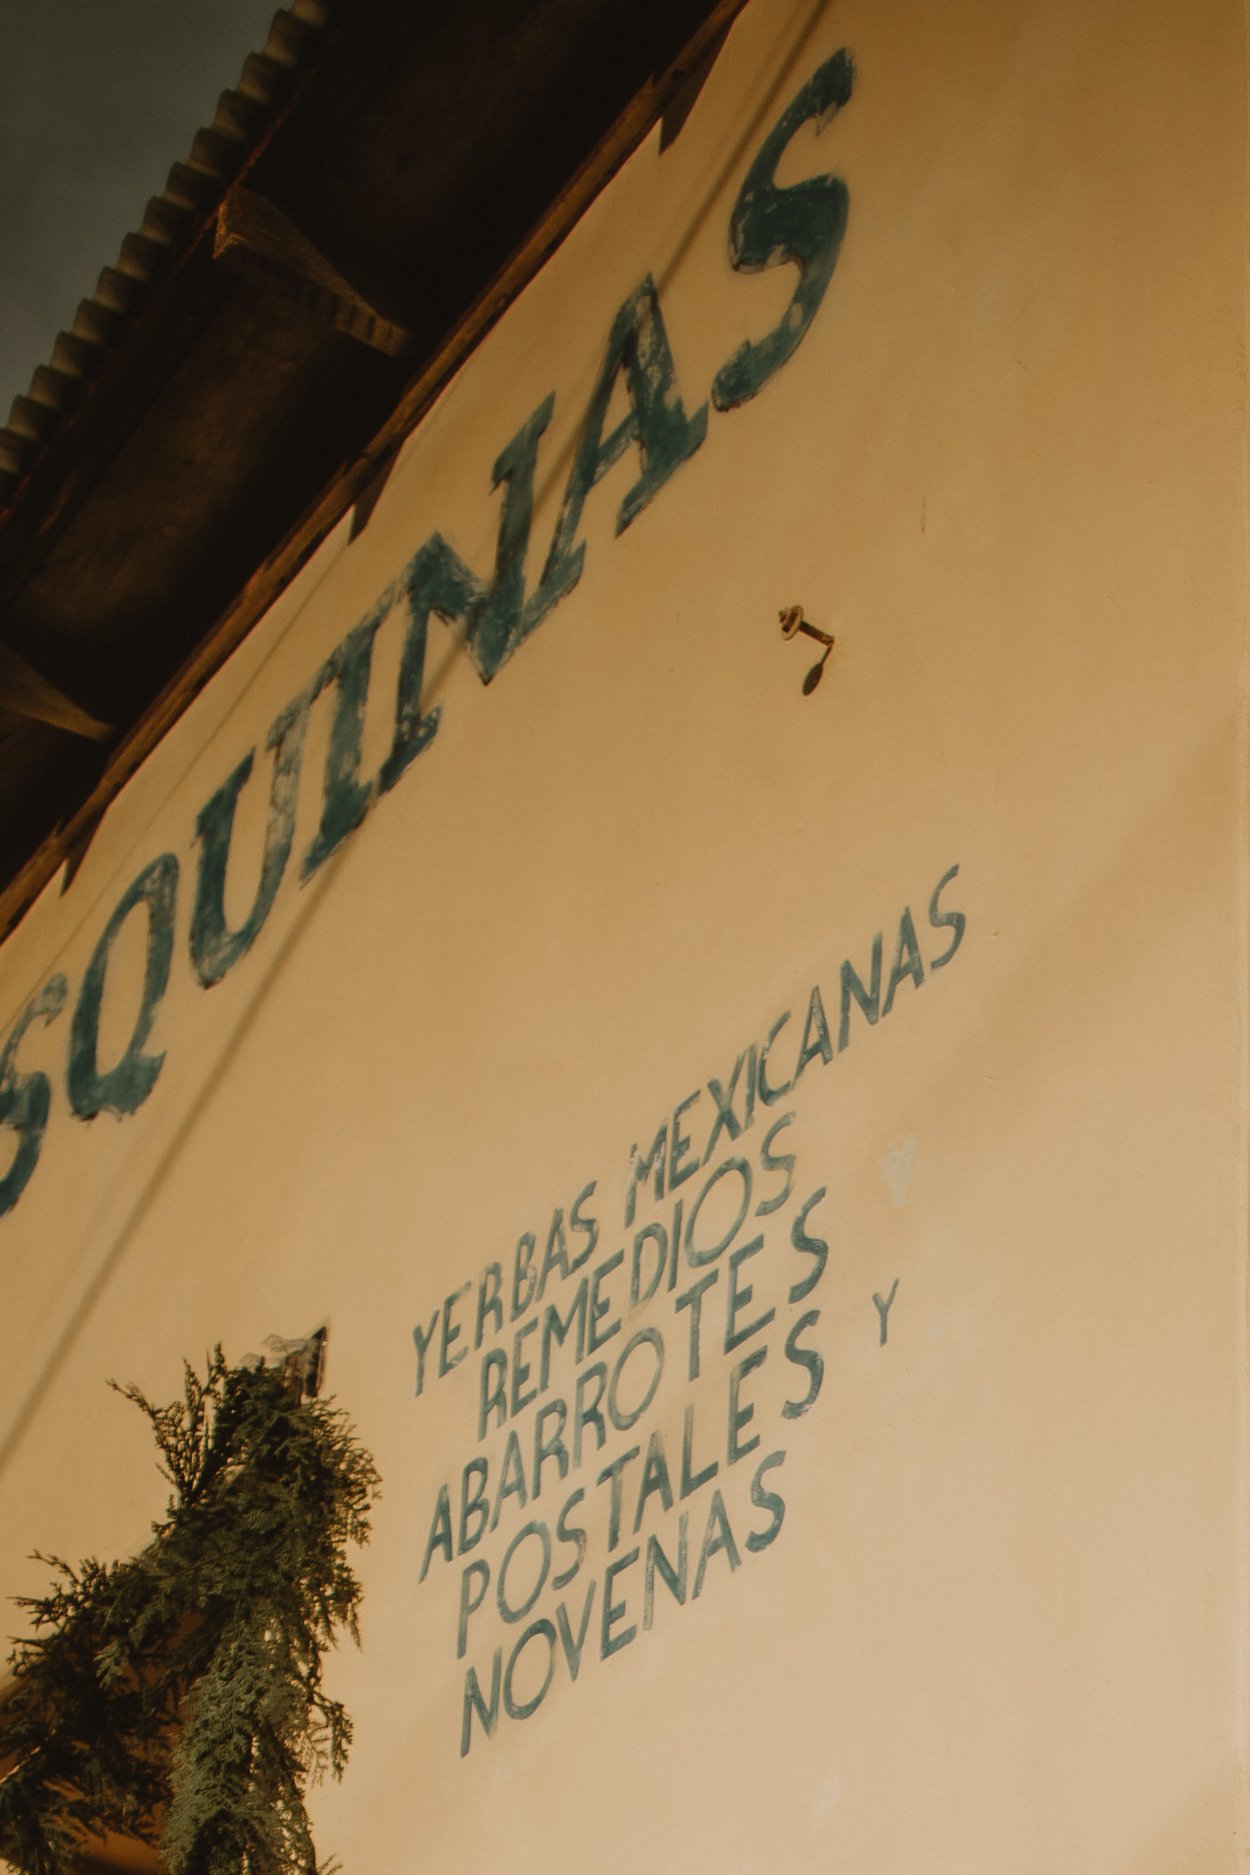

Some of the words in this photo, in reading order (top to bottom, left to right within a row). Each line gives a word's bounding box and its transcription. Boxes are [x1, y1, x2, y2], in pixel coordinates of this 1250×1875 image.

[411, 1180, 598, 1398] YERBAS
[625, 863, 967, 1203] MEXICANAS
[478, 1111, 797, 1443] REMEDIOS
[419, 1185, 830, 1585] ABARROTES
[458, 1309, 825, 1660] POSTALES
[872, 1278, 899, 1347] Y
[460, 1450, 787, 1758] NOVENAS
